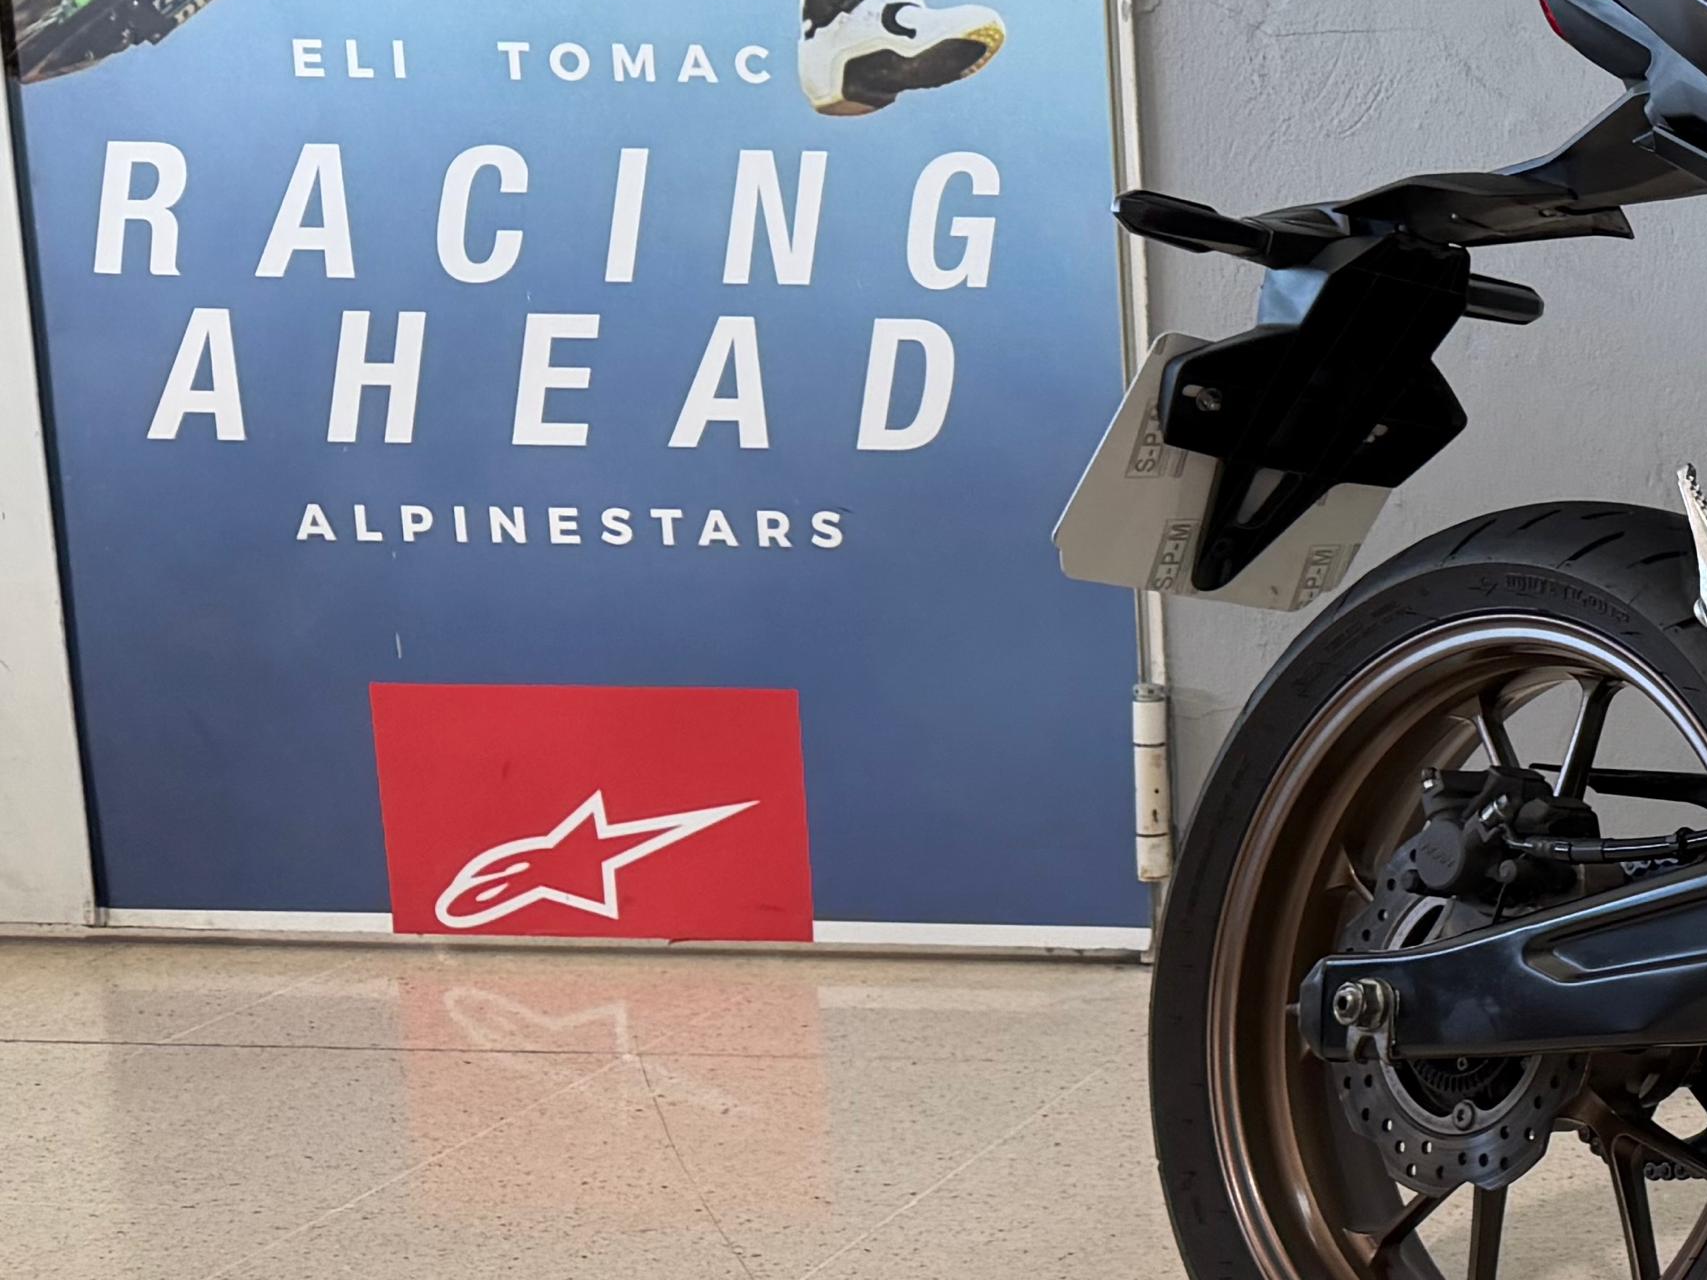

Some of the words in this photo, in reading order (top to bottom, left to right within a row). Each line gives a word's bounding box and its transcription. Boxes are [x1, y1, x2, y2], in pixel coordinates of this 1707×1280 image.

[294, 39, 408, 79] ELI
[497, 41, 773, 84] TOMAC
[93, 141, 1002, 290] RACING
[146, 307, 955, 451] AHEAD
[295, 502, 846, 548] ALPINESTARS
[1154, 523, 1191, 590] S-P-M
